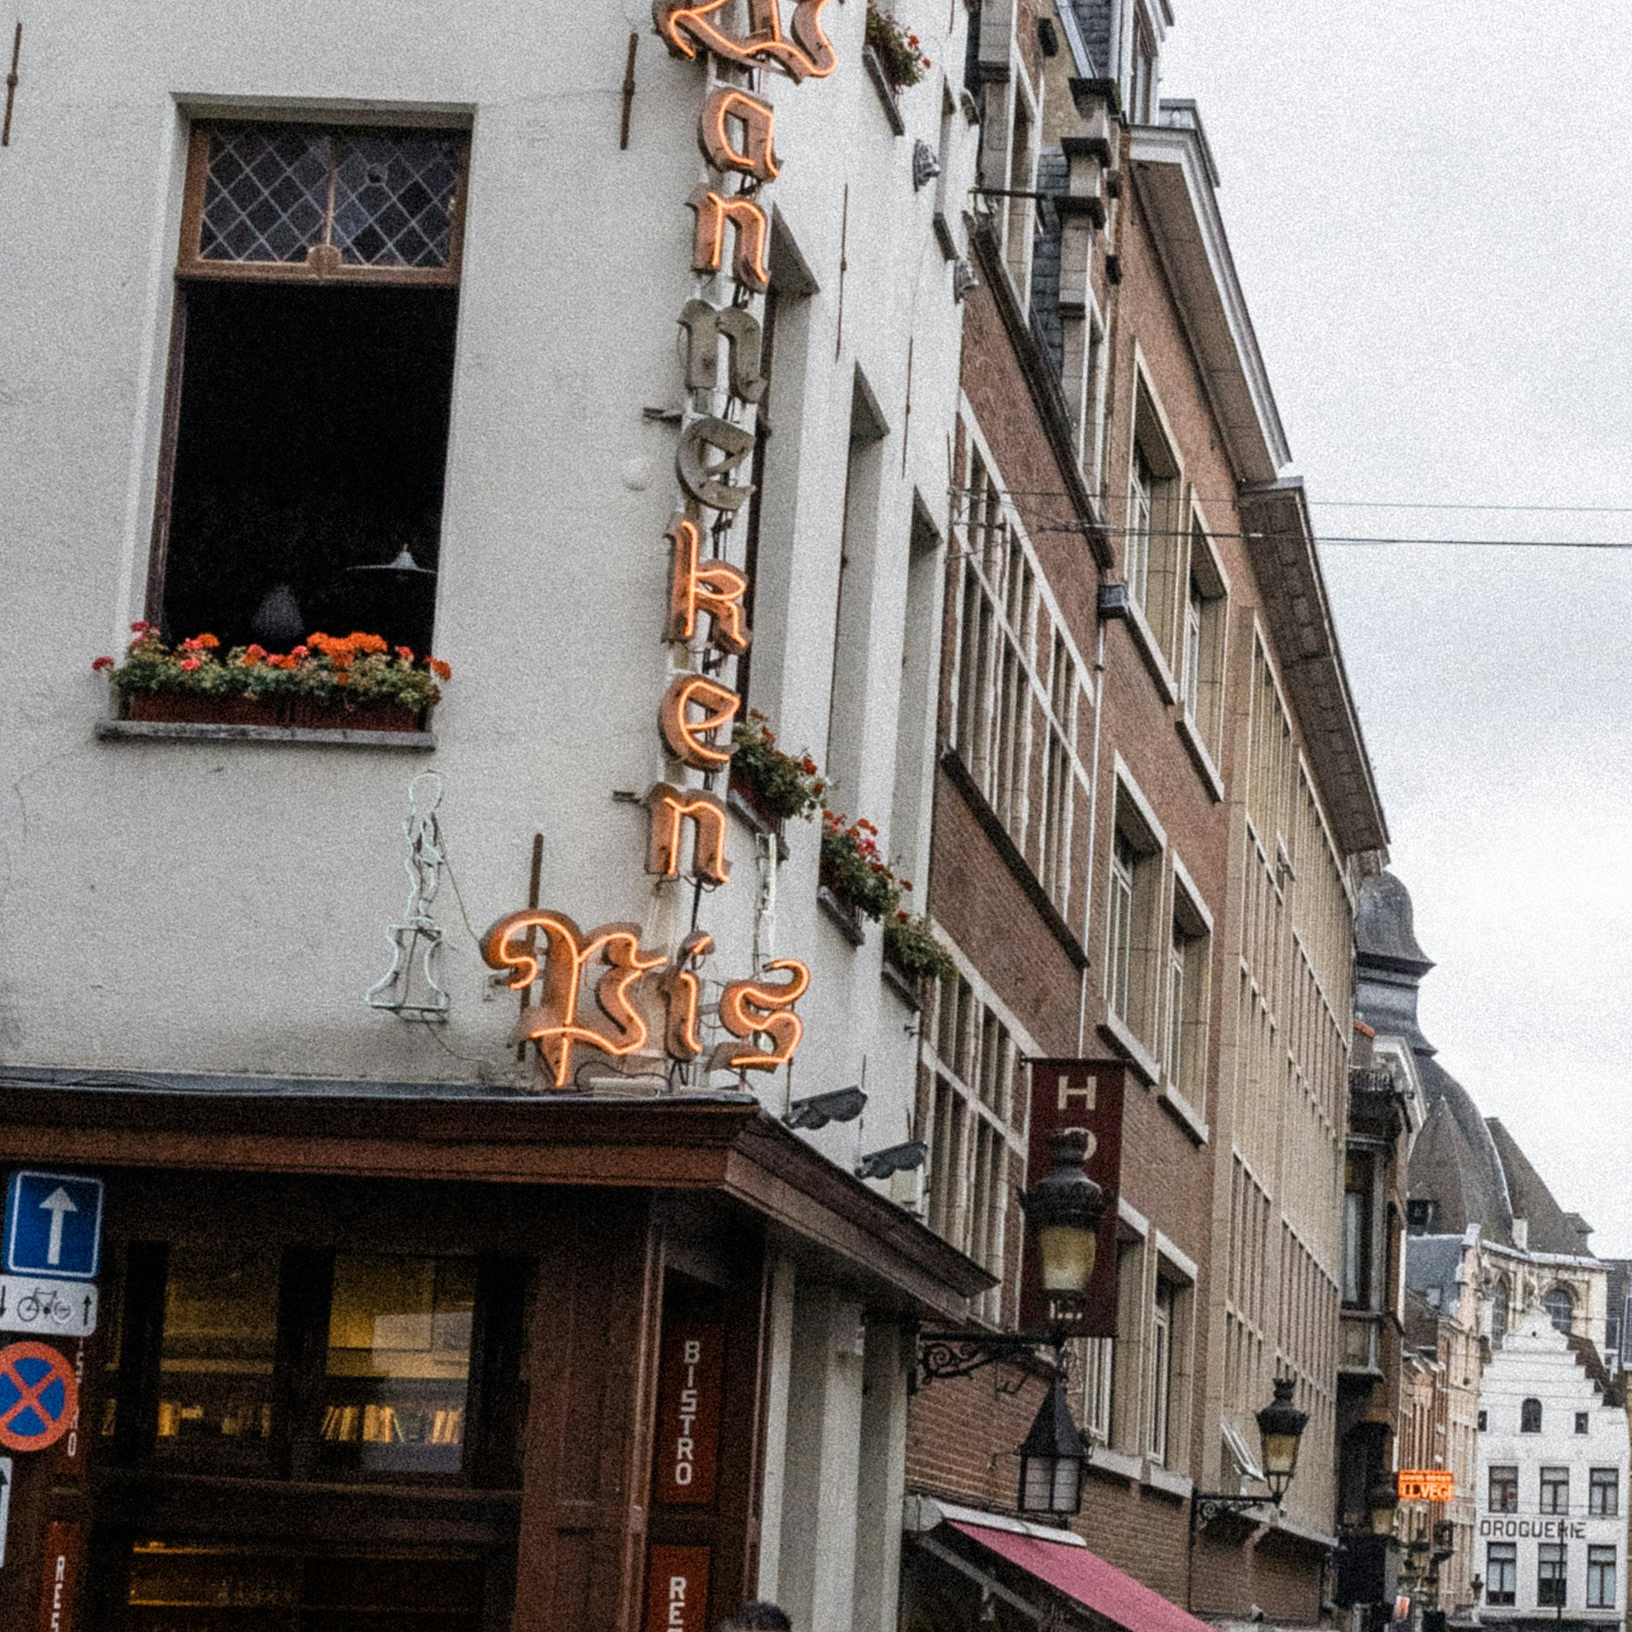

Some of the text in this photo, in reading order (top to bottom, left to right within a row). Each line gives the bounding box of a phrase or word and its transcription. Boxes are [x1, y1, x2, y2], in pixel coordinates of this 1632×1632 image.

[481, 909, 811, 1087] Pis
[675, 1340, 701, 1486] BISTRO
[1480, 1519, 1587, 1539] DROGUERIE
